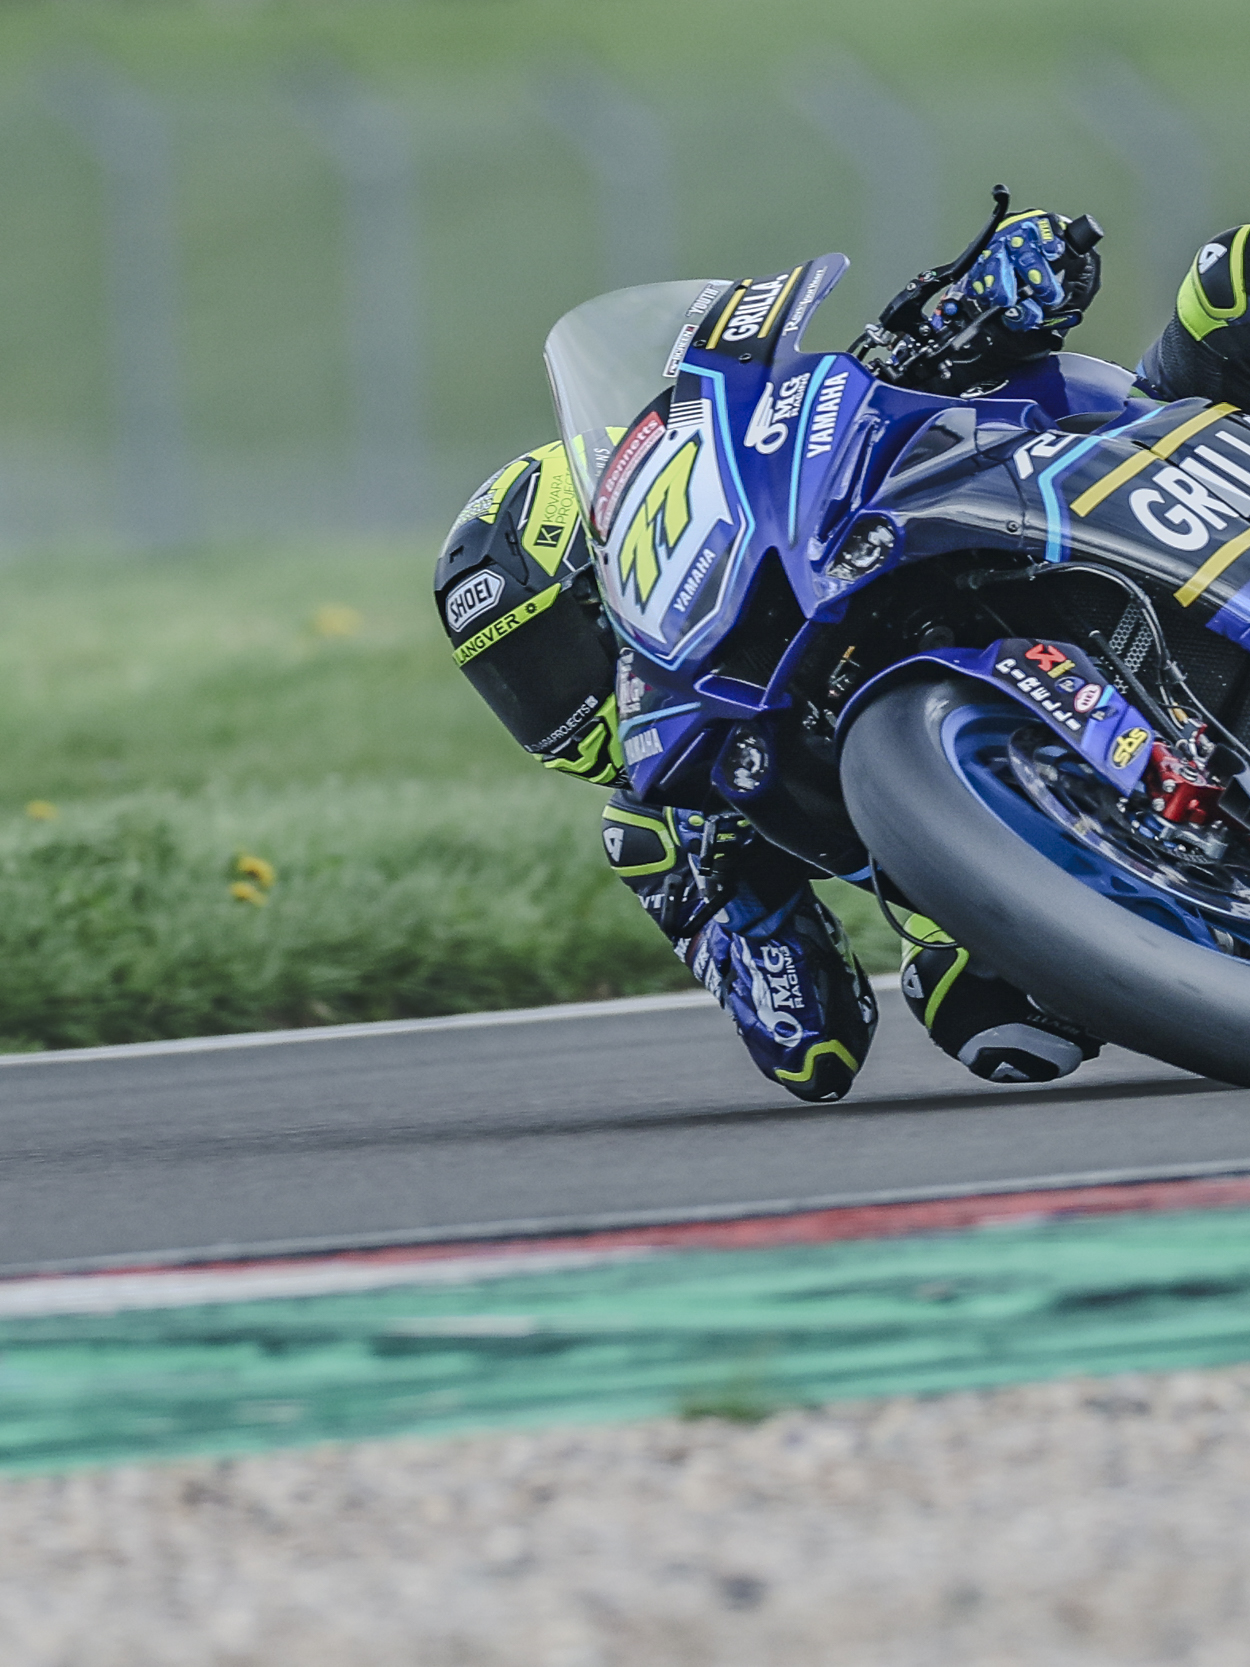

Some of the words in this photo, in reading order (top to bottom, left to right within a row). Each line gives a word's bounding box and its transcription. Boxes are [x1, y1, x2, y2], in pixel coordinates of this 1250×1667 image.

[805, 371, 849, 458] YAMAHA
[542, 474, 563, 523] KOVARA
[618, 437, 700, 608] 77
[450, 579, 493, 623] SHOEI
[673, 548, 717, 613] YAMAHA
[779, 945, 805, 1009] RACING
